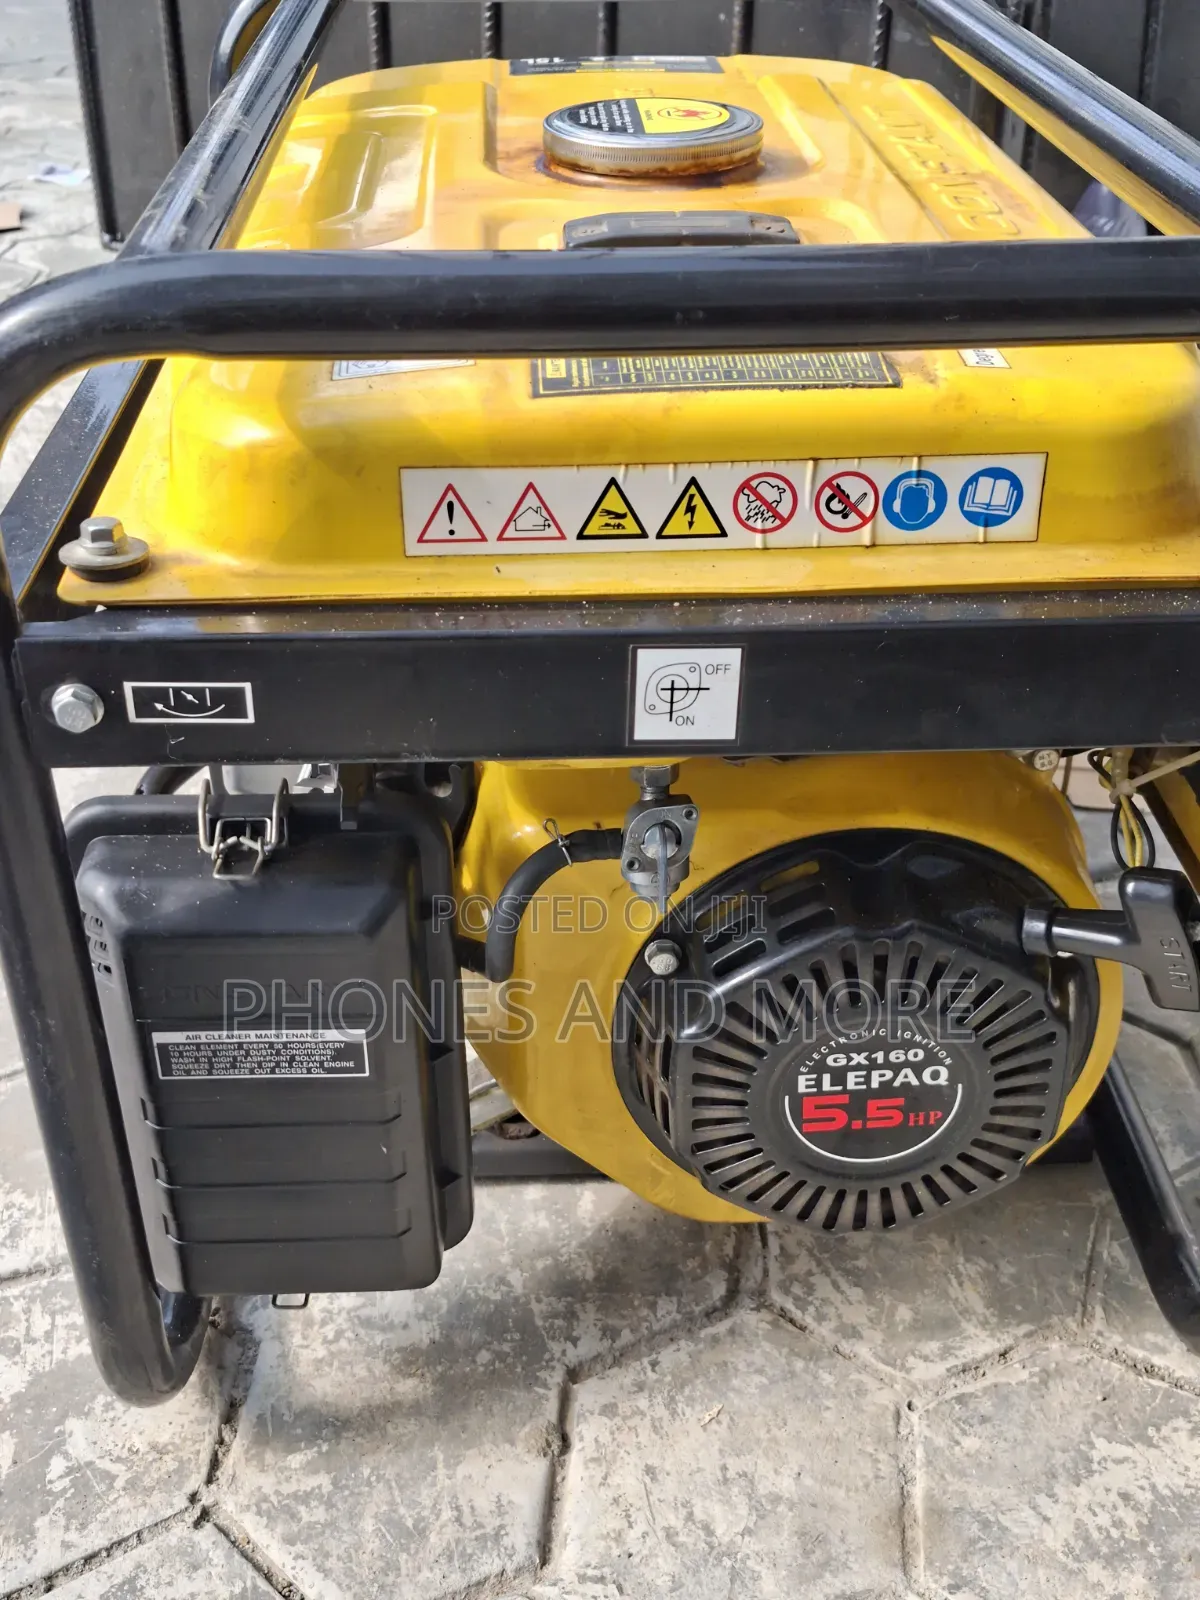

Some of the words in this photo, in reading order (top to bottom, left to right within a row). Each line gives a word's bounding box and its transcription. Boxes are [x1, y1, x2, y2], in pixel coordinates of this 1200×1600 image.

[704, 663, 732, 676] OFF
[674, 715, 695, 727] ON
[1159, 936, 1193, 993] START
[205, 1033, 252, 1041] CLEANER
[254, 1032, 327, 1040] MAINTENANCE
[243, 1042, 270, 1050] EVERY
[249, 1048, 277, 1056] DUSTY
[799, 1027, 887, 1074] ELECTRONIC
[896, 1029, 954, 1066] IGNITION
[294, 1054, 333, 1062] SOLVENT.
[825, 1048, 925, 1067] GX160
[171, 1062, 211, 1070] SQUEEZE
[235, 1061, 258, 1069] THEN
[292, 1060, 320, 1068] CLEAN
[323, 1060, 355, 1068] ENGINE
[190, 1068, 209, 1076] AND
[254, 1067, 271, 1075] OUT
[275, 1066, 307, 1074] EXCESS
[311, 1066, 328, 1074] OIL.
[797, 1065, 949, 1094] ELEPAQ
[802, 1093, 906, 1133] 5.5
[907, 1110, 944, 1127] HP
